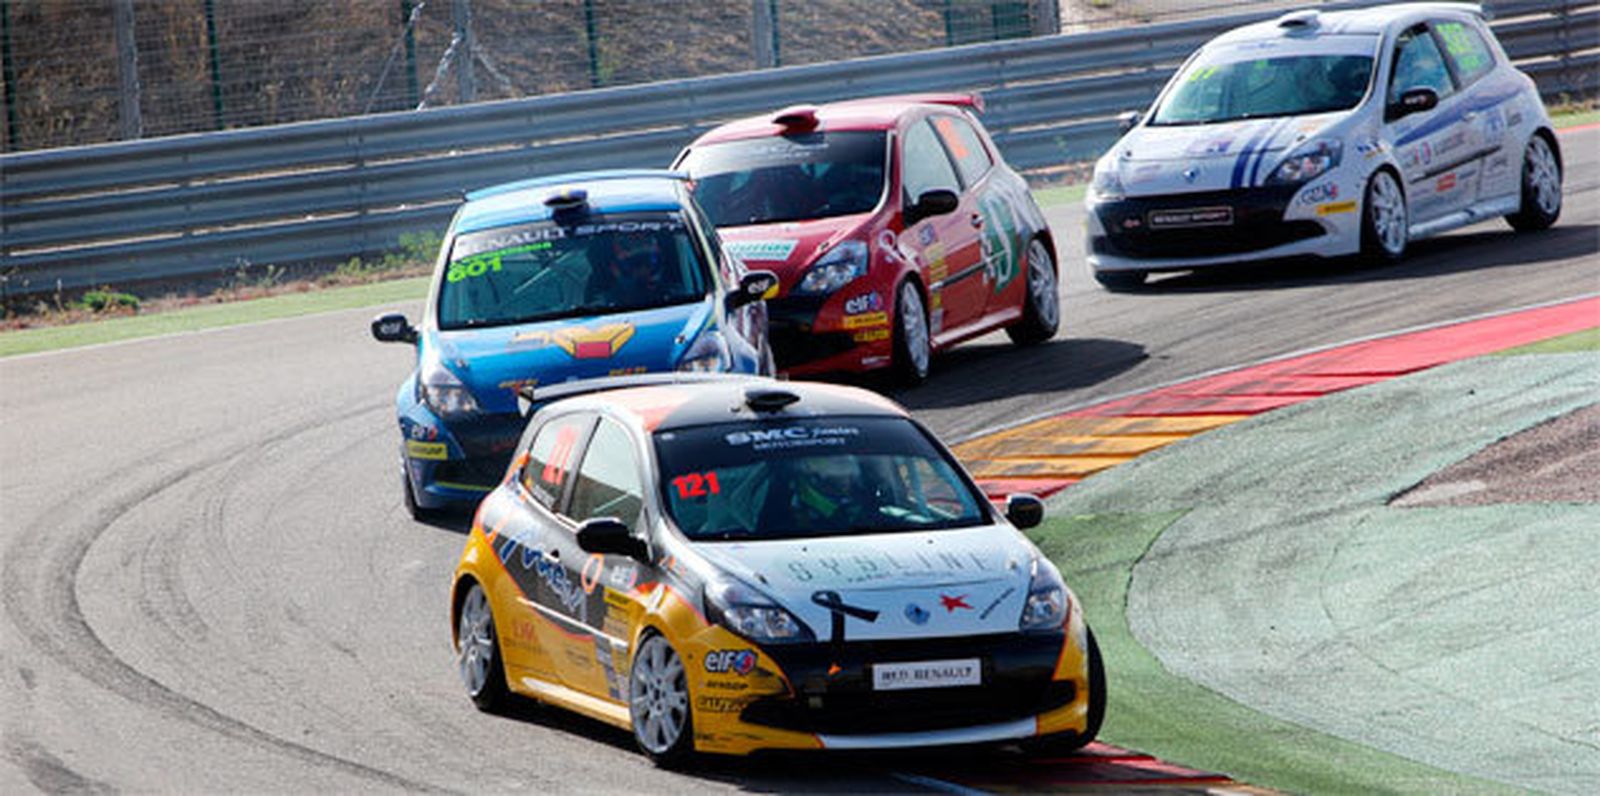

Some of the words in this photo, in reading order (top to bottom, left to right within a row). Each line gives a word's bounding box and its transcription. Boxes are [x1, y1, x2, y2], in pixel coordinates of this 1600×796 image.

[573, 221, 683, 236] SPORT
[447, 256, 502, 282] 601
[845, 294, 869, 313] elf
[725, 427, 809, 446] SMC
[671, 471, 720, 499] 121
[705, 650, 737, 672] elf
[914, 666, 972, 680] RENAULT
